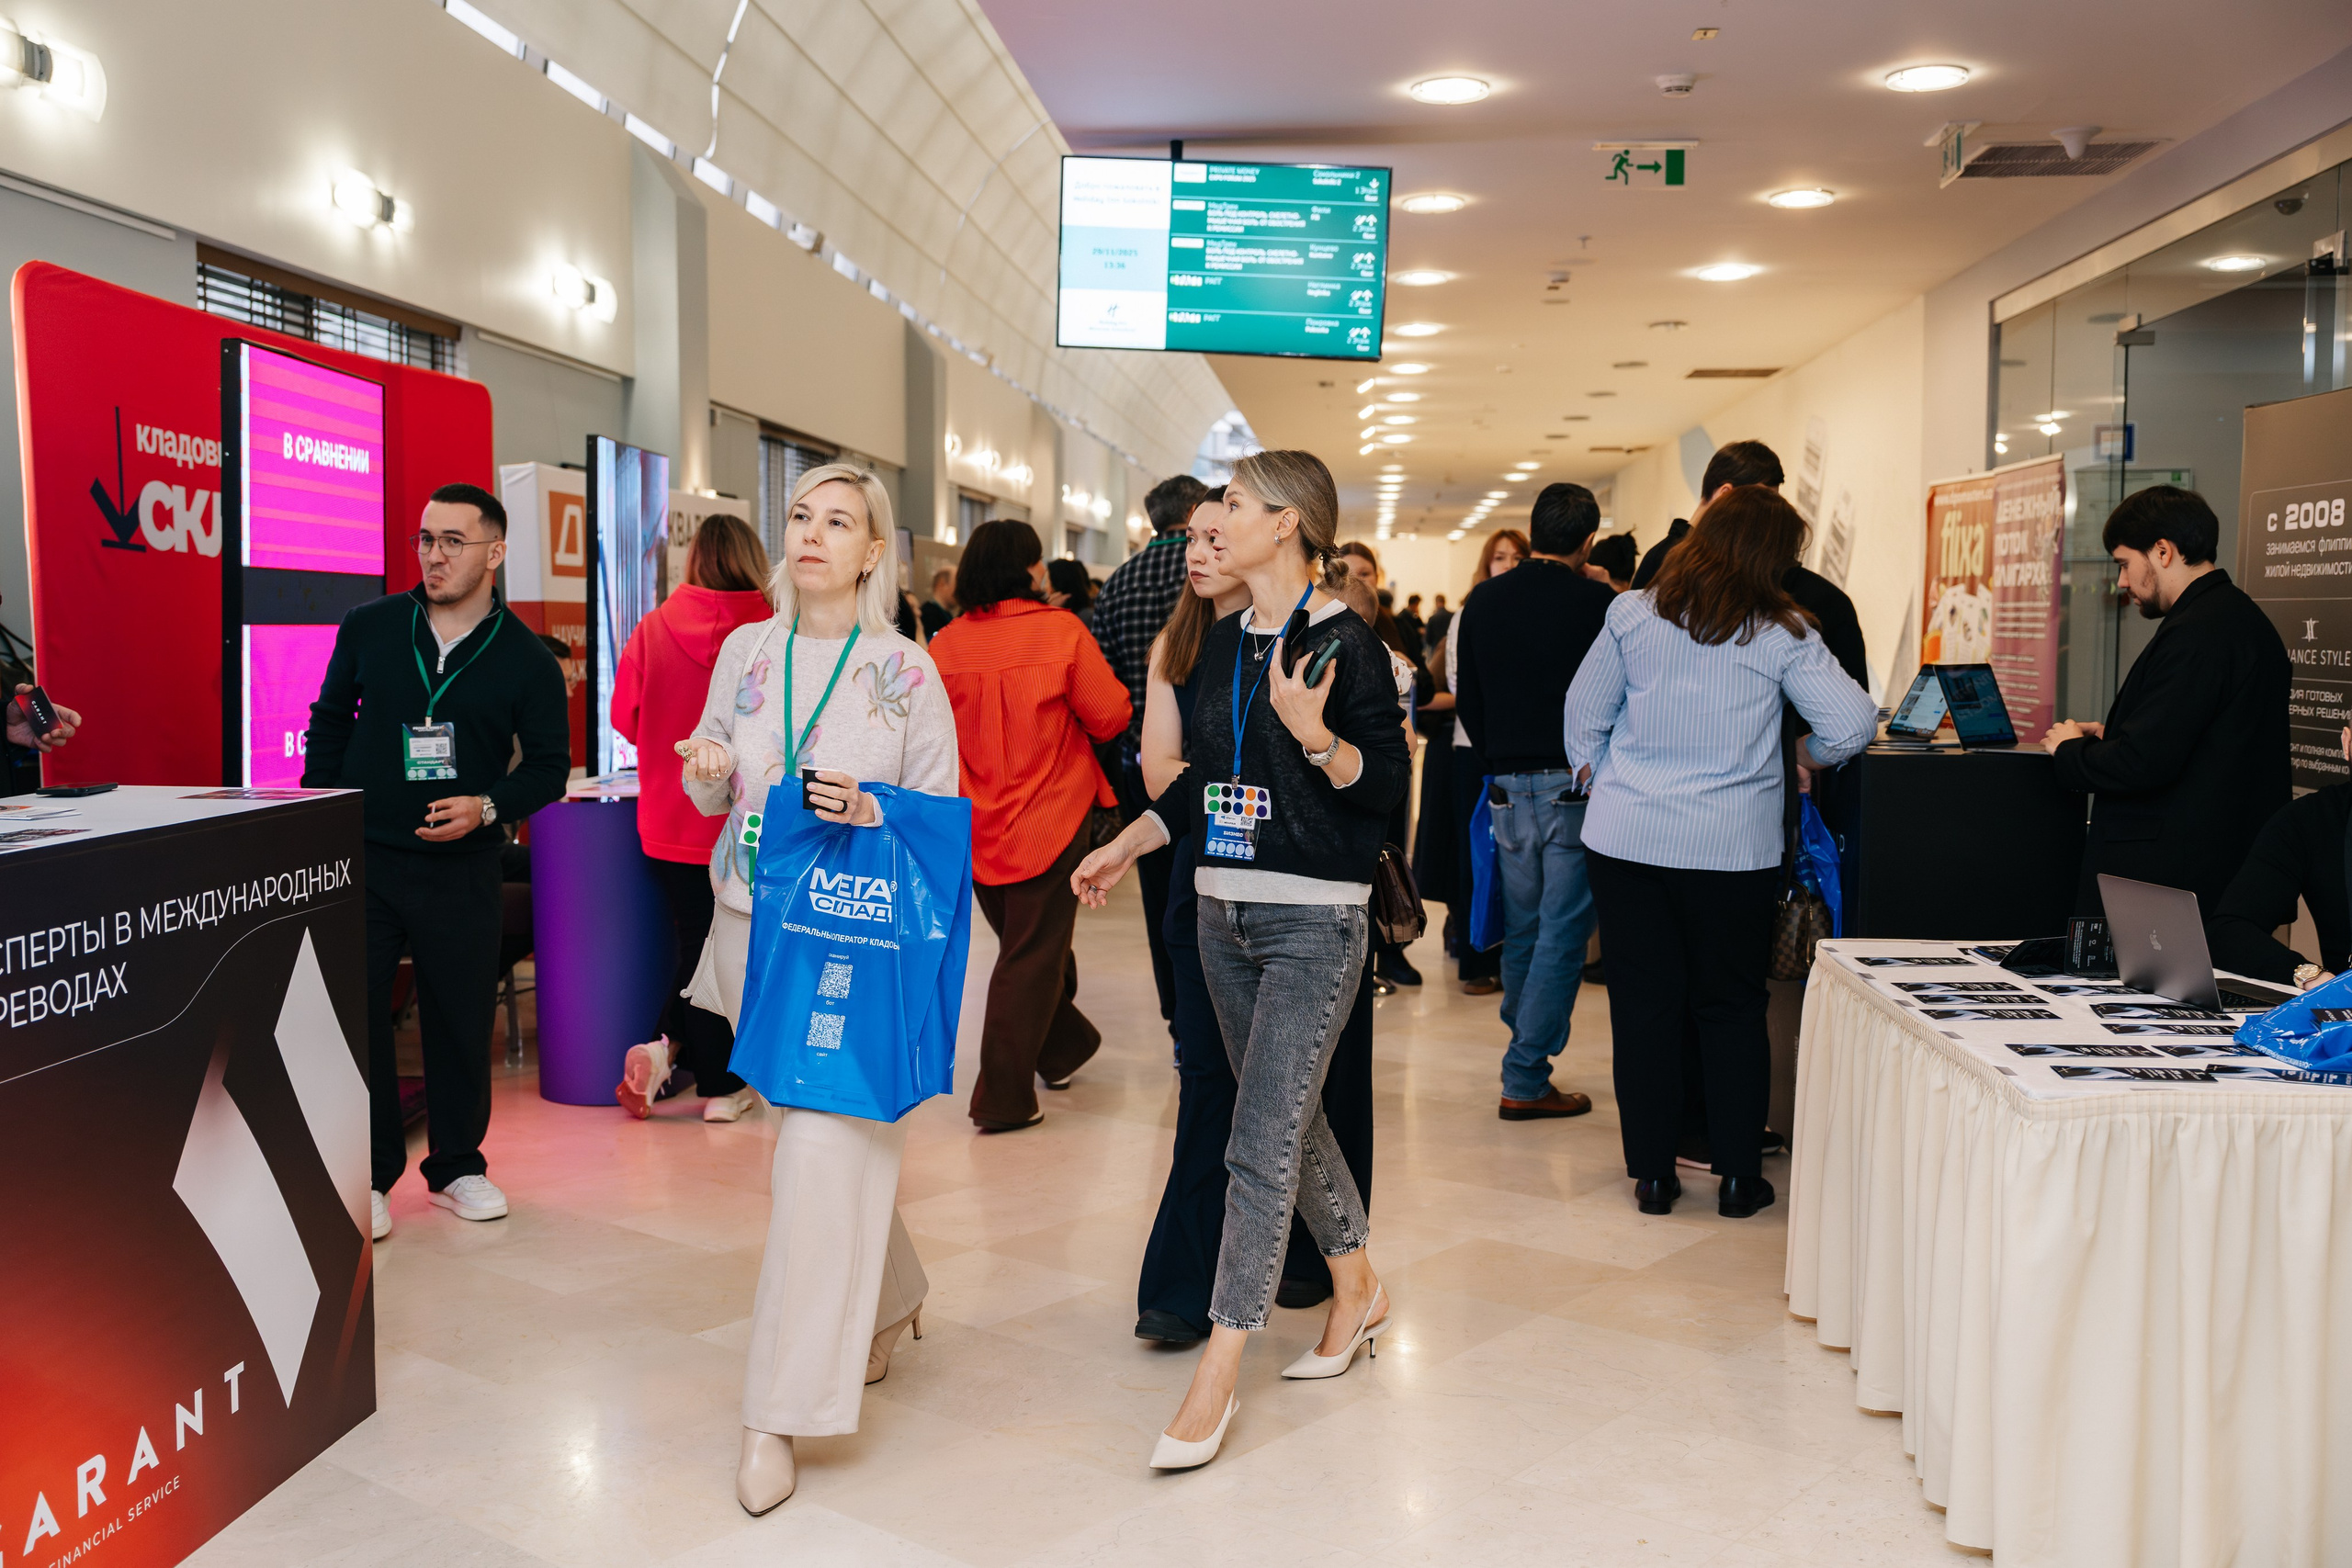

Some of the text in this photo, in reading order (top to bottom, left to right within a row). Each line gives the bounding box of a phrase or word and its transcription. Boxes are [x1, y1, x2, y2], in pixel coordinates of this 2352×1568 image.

[136, 423, 221, 469] кладов
[283, 432, 369, 474] В СРАВНЕНИИ
[2284, 498, 2346, 531] 2008
[2266, 539, 2315, 556] занимаемся
[2265, 561, 2290, 578] жилой
[2288, 649, 2351, 667] ANCE STYLE
[31, 700, 47, 724] GARANT
[2306, 690, 2343, 704] ГОТОВЫХ
[0, 858, 351, 976] ПЕРТЫ В МЕЖДУНАРОДНЫХ
[0, 1360, 244, 1568] ARANT
[128, 1475, 180, 1522] SERVICE
